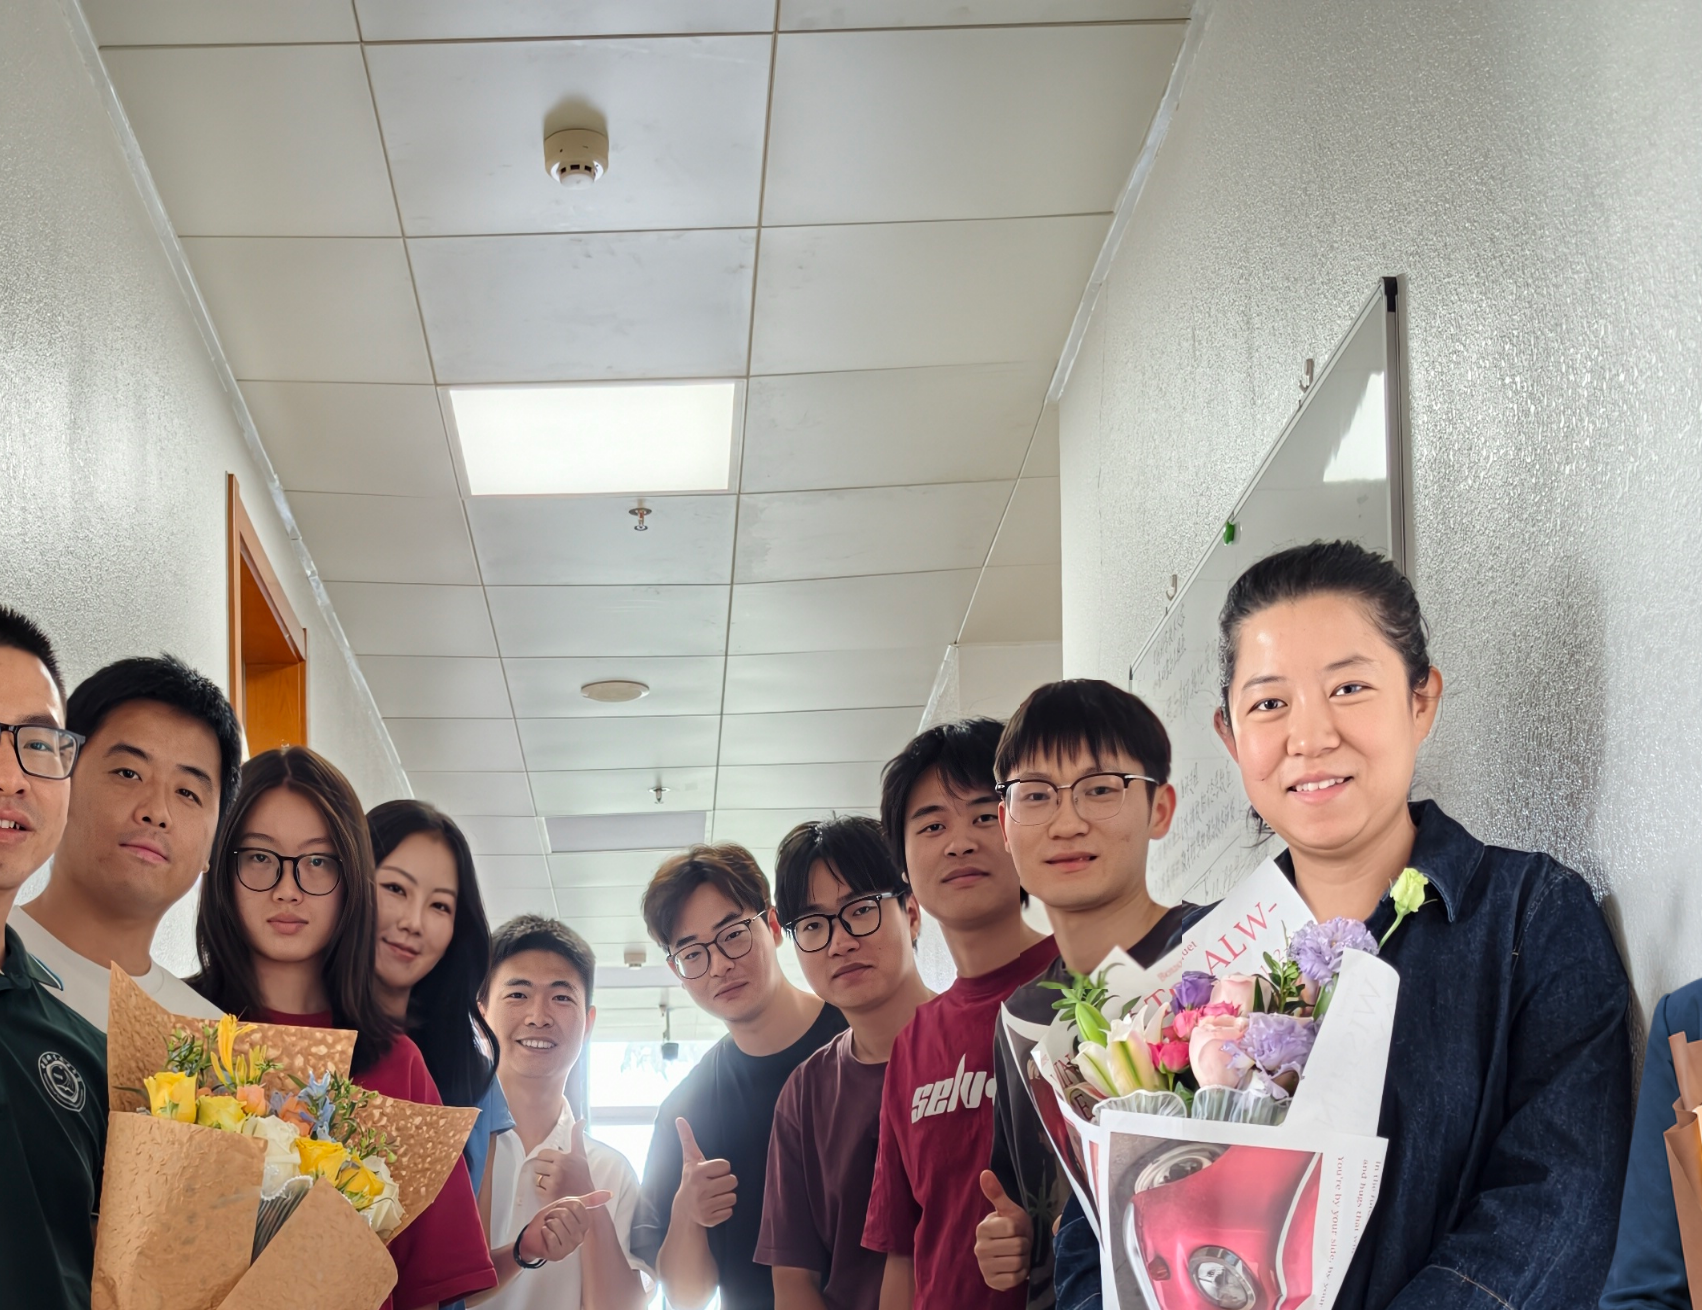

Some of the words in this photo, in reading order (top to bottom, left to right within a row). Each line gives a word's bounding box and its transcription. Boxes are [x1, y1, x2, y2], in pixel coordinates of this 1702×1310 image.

[1335, 1155, 1345, 1190] You're
[1360, 1159, 1369, 1180] and
[1332, 1193, 1342, 1208] by
[1330, 1208, 1339, 1236] your
